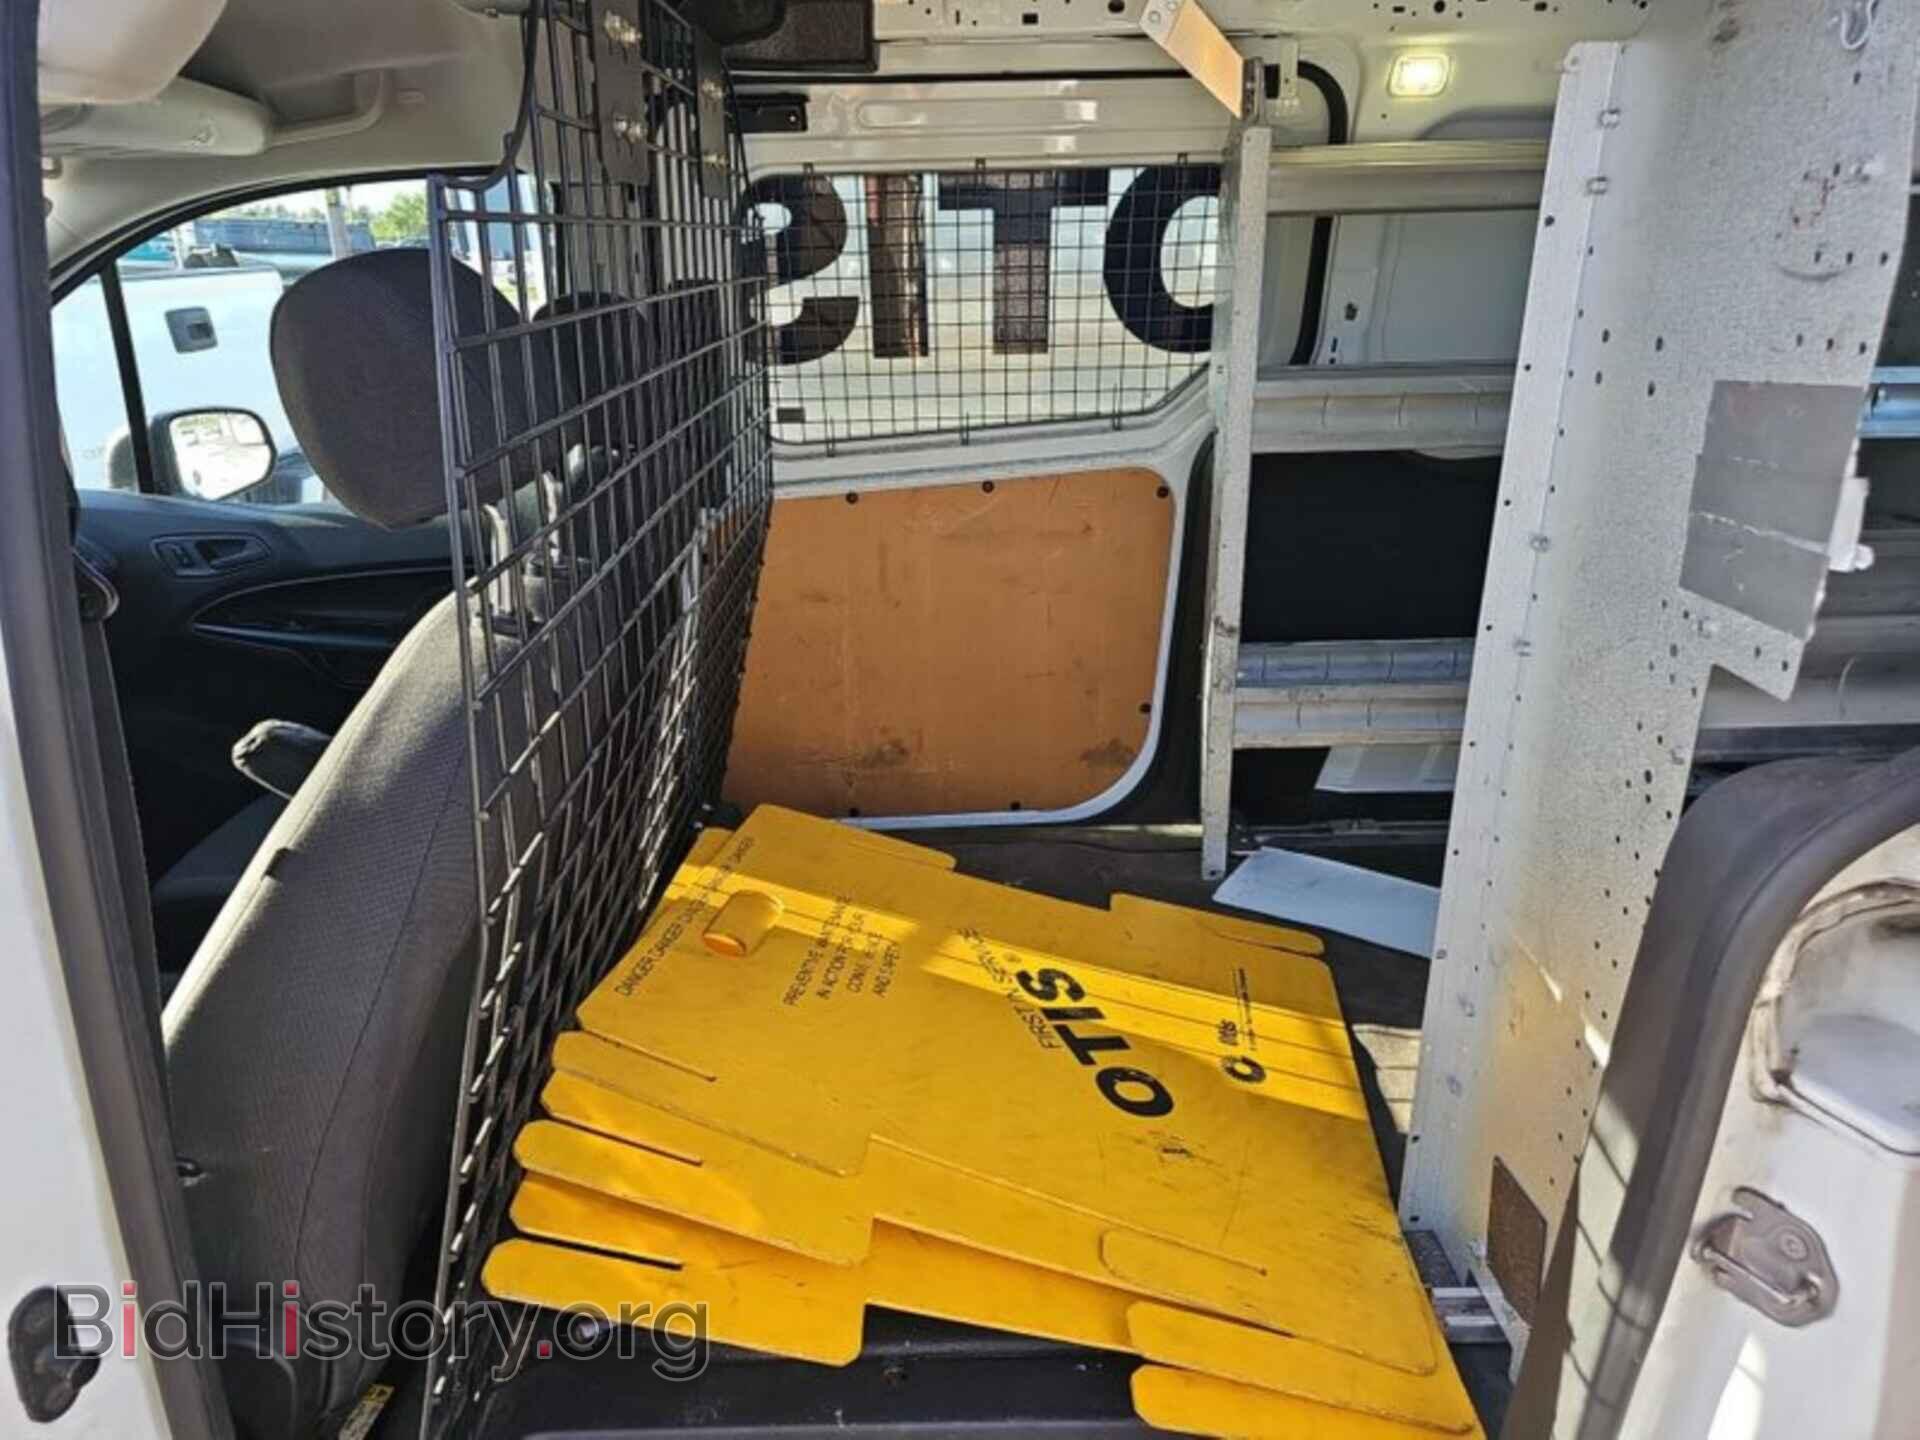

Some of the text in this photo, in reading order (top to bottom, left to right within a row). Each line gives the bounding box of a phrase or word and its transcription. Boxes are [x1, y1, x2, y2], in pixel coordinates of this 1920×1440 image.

[614, 956, 653, 996] DANGER
[648, 922, 685, 959] DANGER
[1013, 1004, 1062, 1049] FIRST
[1015, 968, 1175, 1118] OTIS
